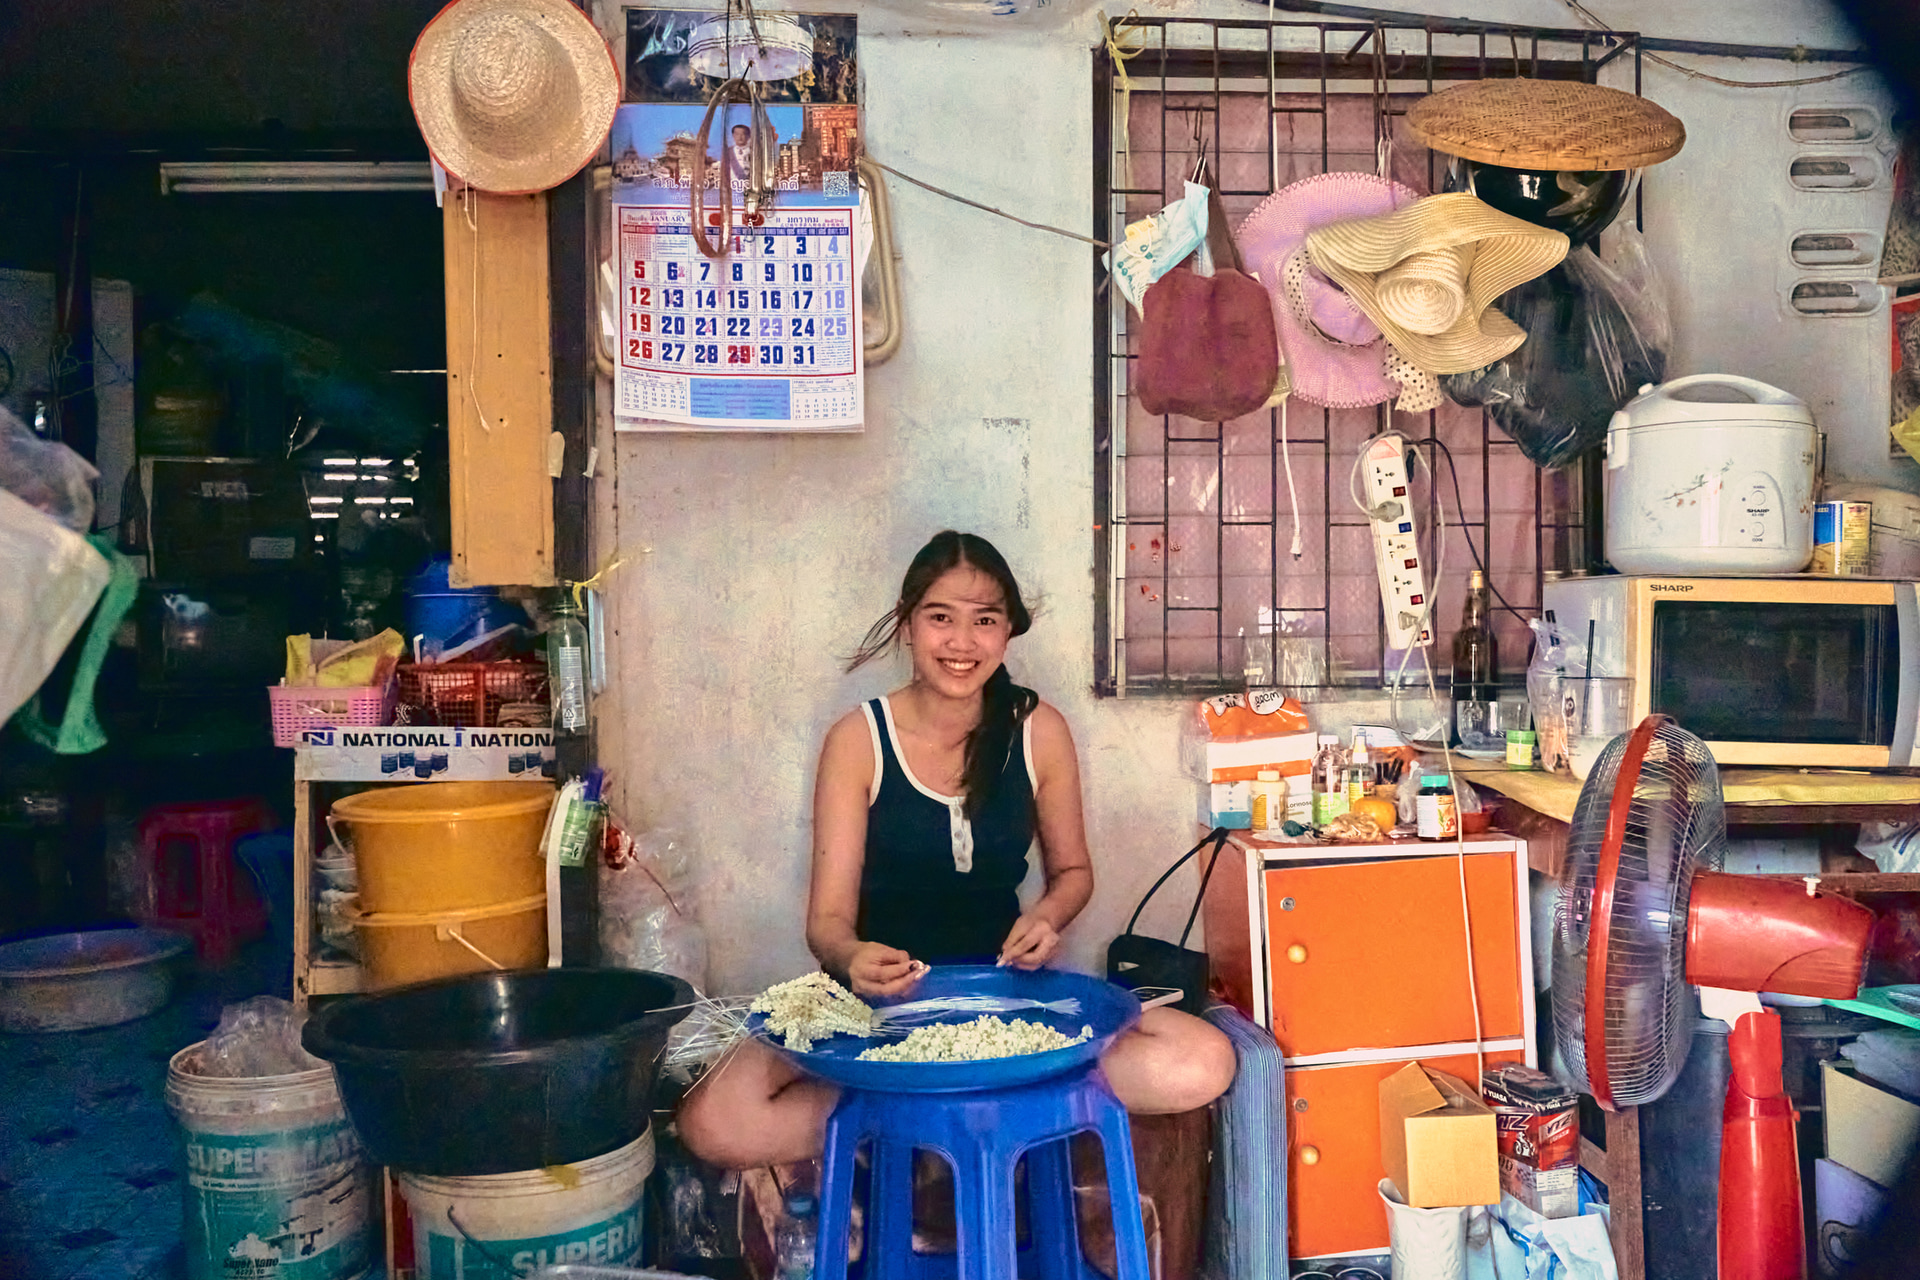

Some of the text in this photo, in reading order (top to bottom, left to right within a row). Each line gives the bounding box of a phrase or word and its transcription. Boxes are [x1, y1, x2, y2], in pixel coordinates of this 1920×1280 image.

[650, 215, 686, 223] JANUARY
[764, 236, 776, 254] 2
[797, 237, 806, 254] 3
[828, 236, 839, 254] 4
[635, 260, 843, 281] 5 6 7 8 9 10 11
[630, 286, 845, 309] 12 13 14 15 16 17 18
[630, 313, 846, 336] 19 20 21 22 23 24 25
[630, 339, 652, 359] 26
[662, 343, 685, 361] 27
[695, 345, 718, 363] 28
[728, 345, 750, 363] 29
[761, 346, 783, 364] 30
[794, 346, 814, 364] 31
[1649, 583, 1694, 593] SHARP
[343, 733, 450, 747] NATIONAL
[1487, 1089, 1508, 1103] YUASA
